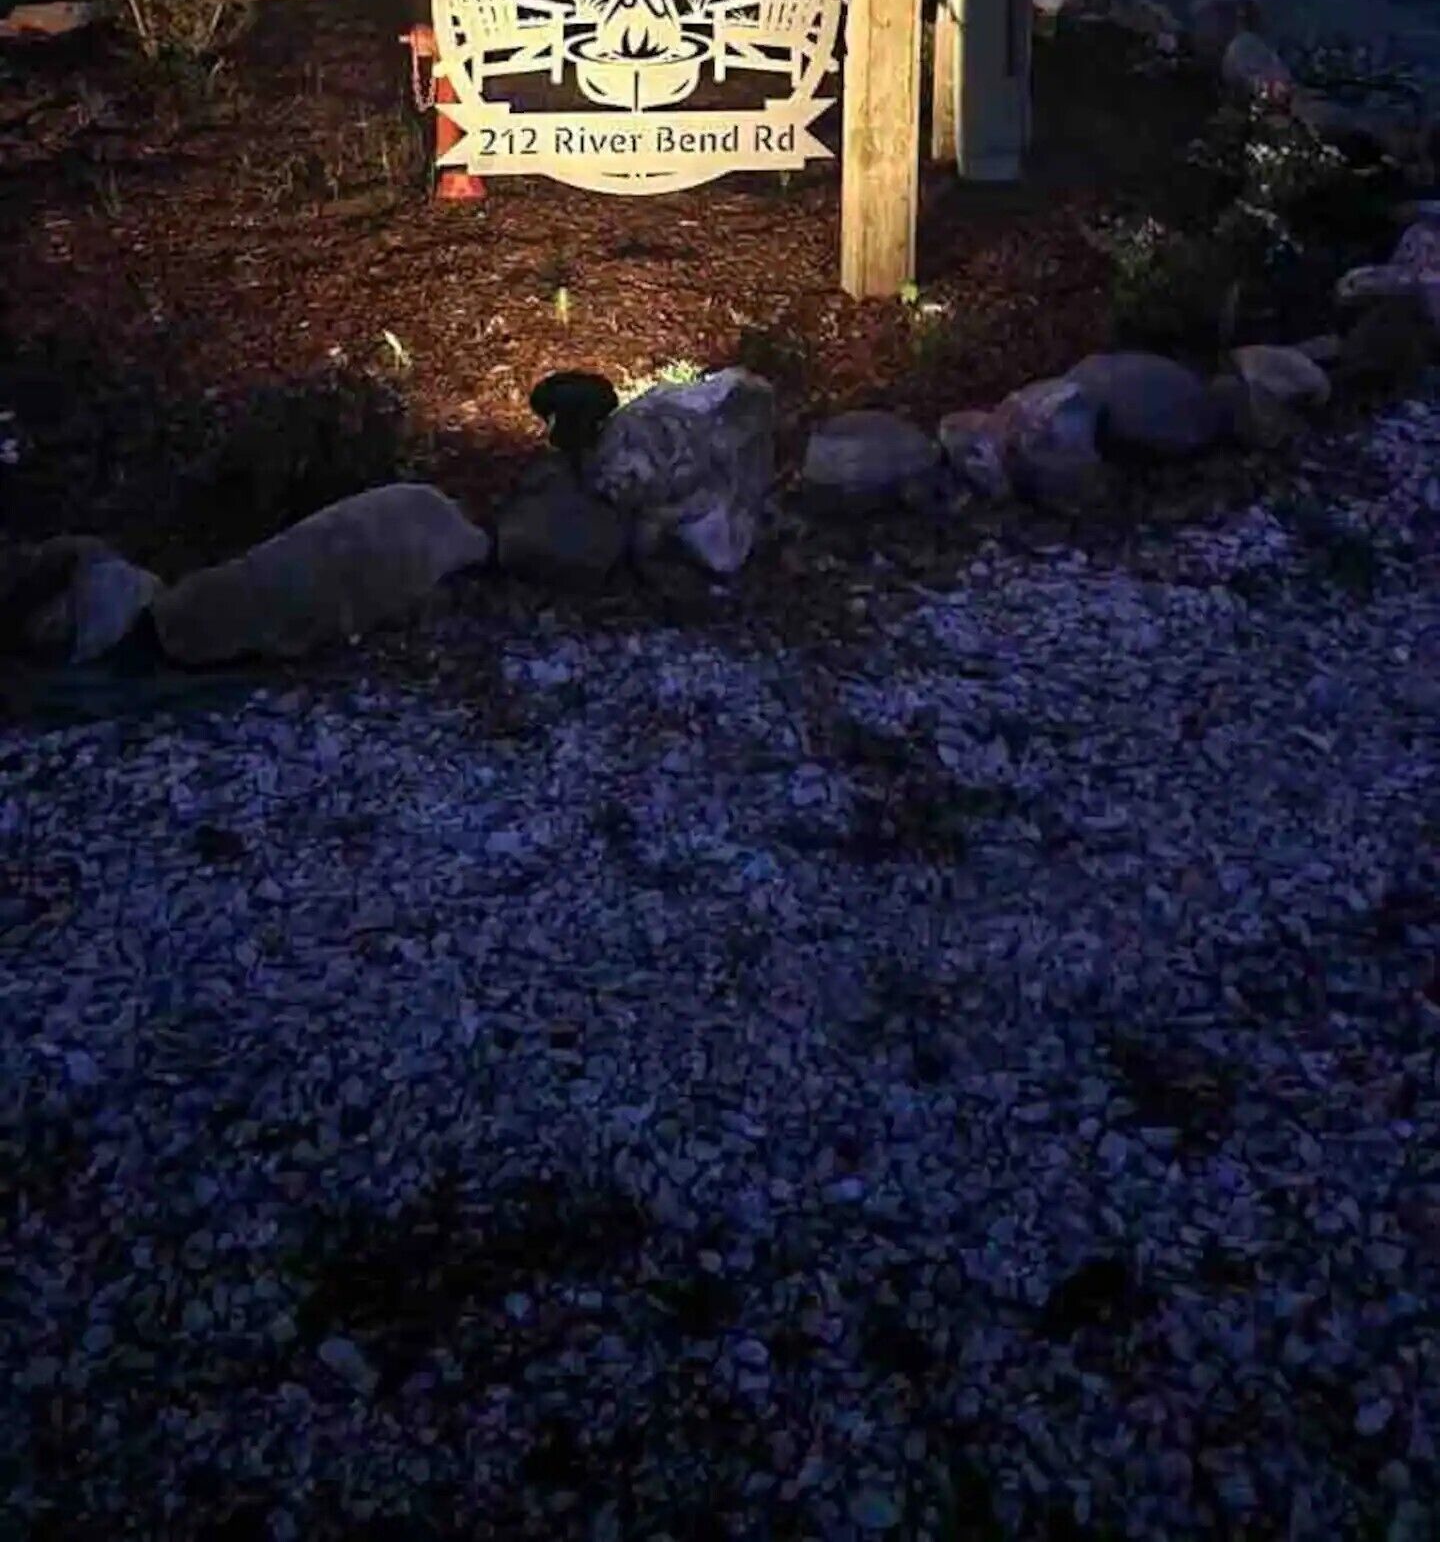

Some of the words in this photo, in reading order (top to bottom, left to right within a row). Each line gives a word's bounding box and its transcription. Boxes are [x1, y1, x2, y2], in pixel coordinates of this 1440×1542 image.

[479, 128, 538, 156] 212
[555, 127, 641, 155] River
[656, 125, 739, 154] Bend
[754, 123, 796, 153] Rd
